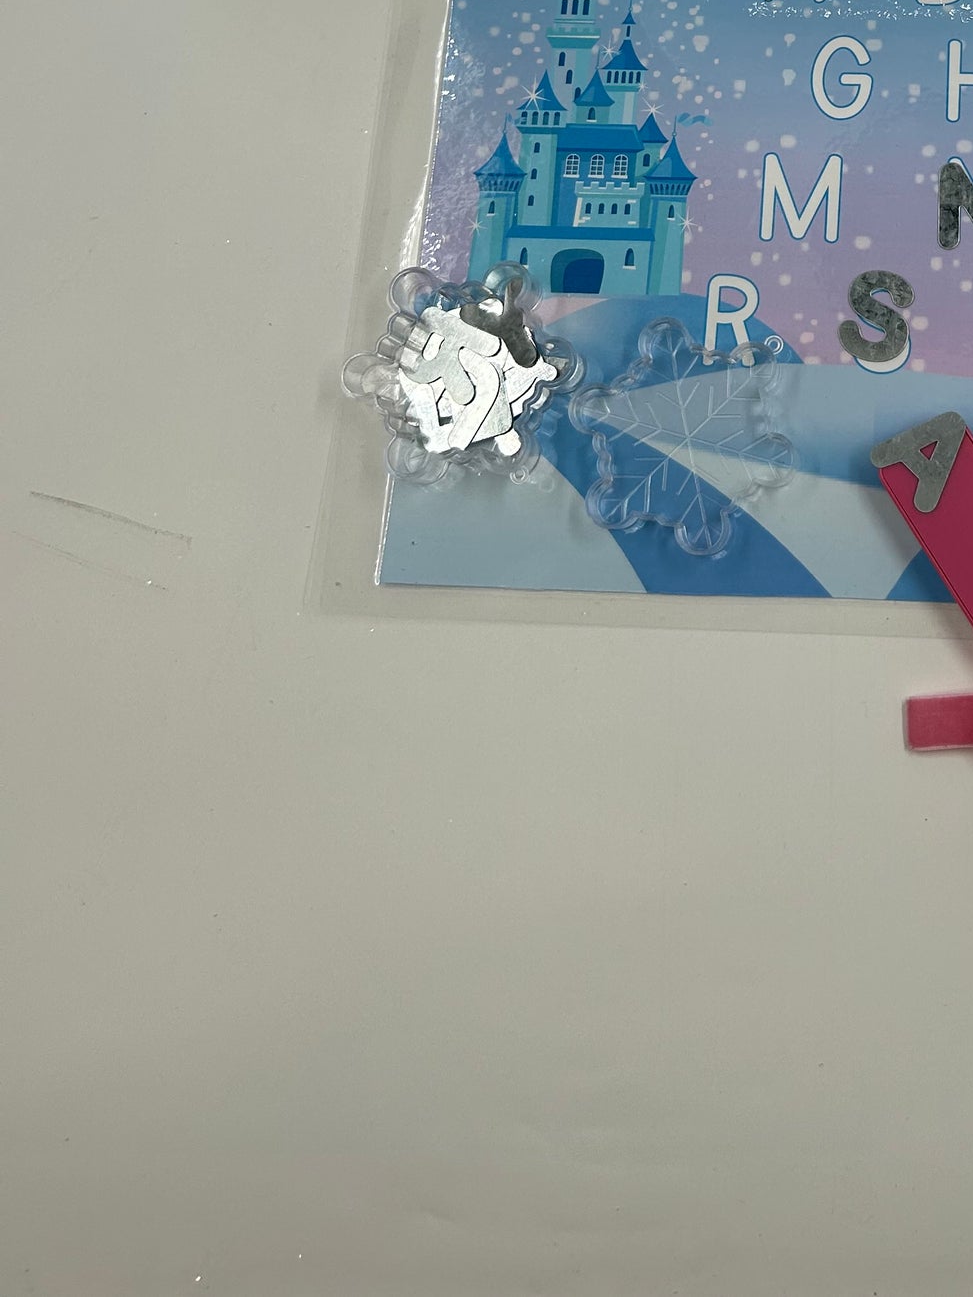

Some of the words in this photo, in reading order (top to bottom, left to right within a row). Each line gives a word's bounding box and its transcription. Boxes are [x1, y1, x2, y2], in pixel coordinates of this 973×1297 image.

[811, 35, 873, 119] G
[759, 152, 843, 242] M
[702, 273, 760, 367] R
[837, 269, 915, 365] S
[870, 411, 967, 513] A
